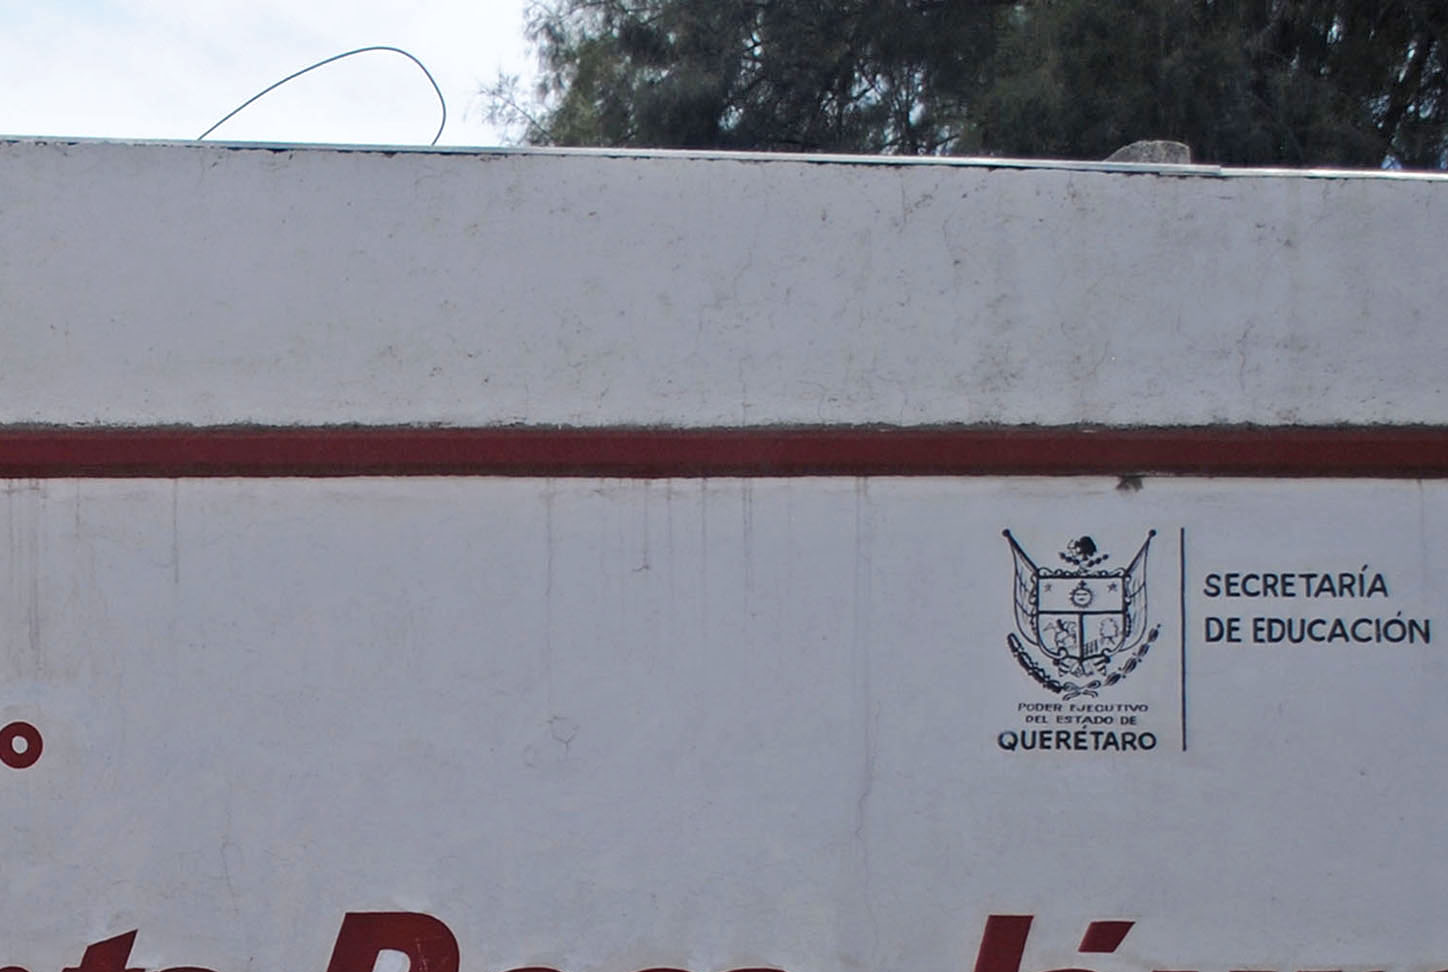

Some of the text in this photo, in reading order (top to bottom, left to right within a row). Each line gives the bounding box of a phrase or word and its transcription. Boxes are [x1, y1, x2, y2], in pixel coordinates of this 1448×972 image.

[1203, 564, 1389, 599] SECRETARÍA
[1204, 610, 1431, 645] DE EDUCACIÓN
[1017, 702, 1149, 713] PODER EJECUTIVO
[1025, 714, 1138, 726] DEL ESTADO DE
[997, 725, 1158, 752] QUERÉTARO
